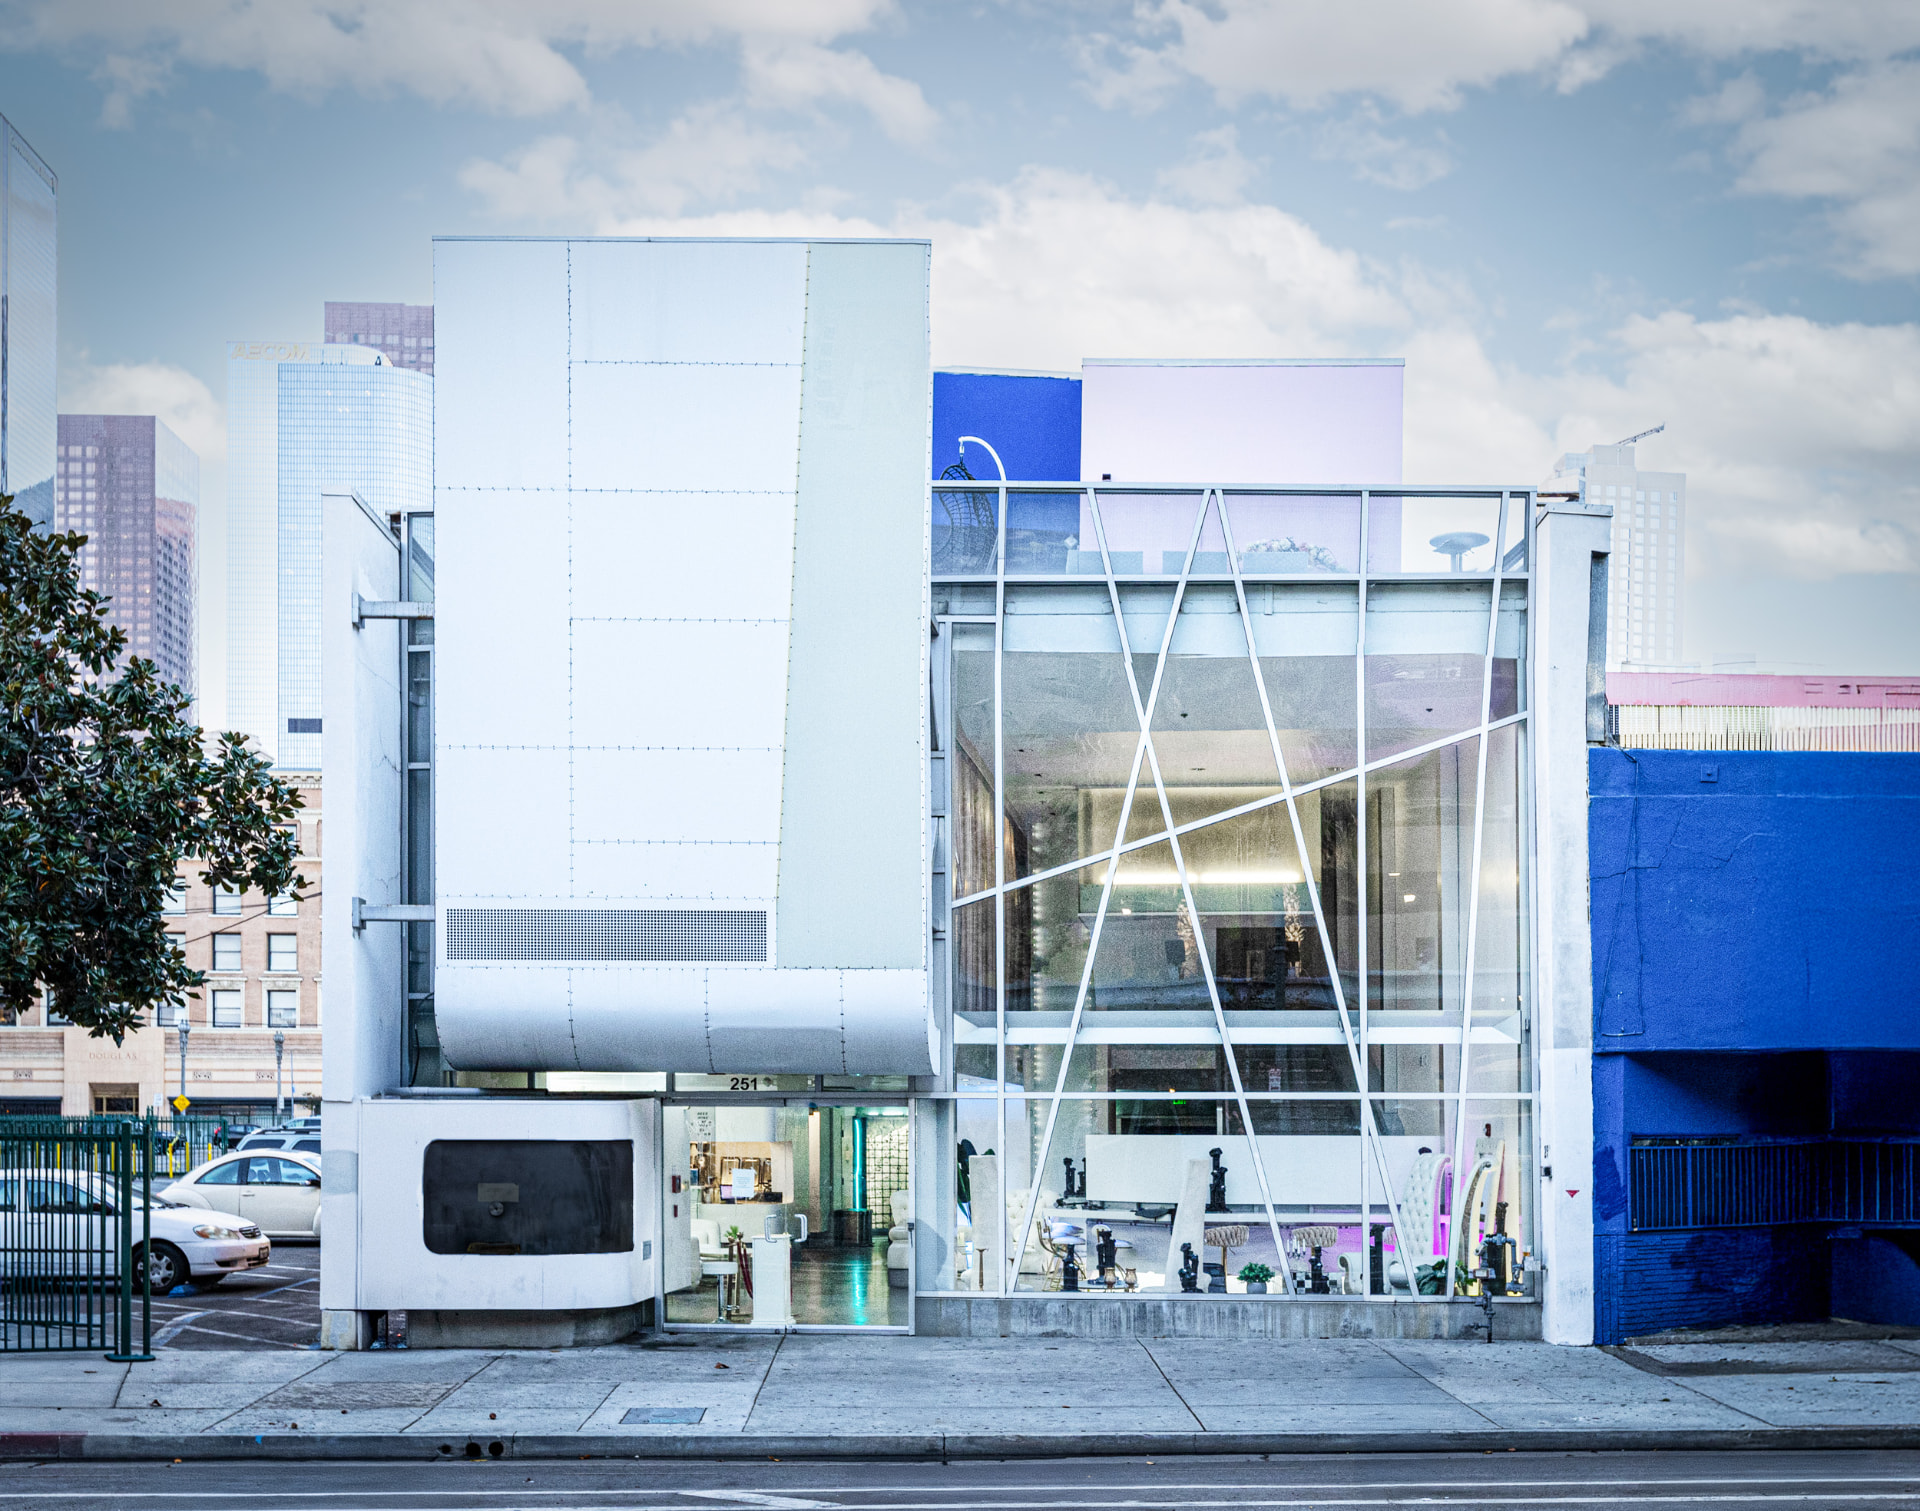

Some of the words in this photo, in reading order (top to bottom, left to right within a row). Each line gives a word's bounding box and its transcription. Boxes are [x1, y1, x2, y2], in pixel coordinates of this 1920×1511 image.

[231, 343, 310, 360] AECOM
[89, 1052, 137, 1060] DOUGLAS
[730, 1077, 758, 1091] 251
